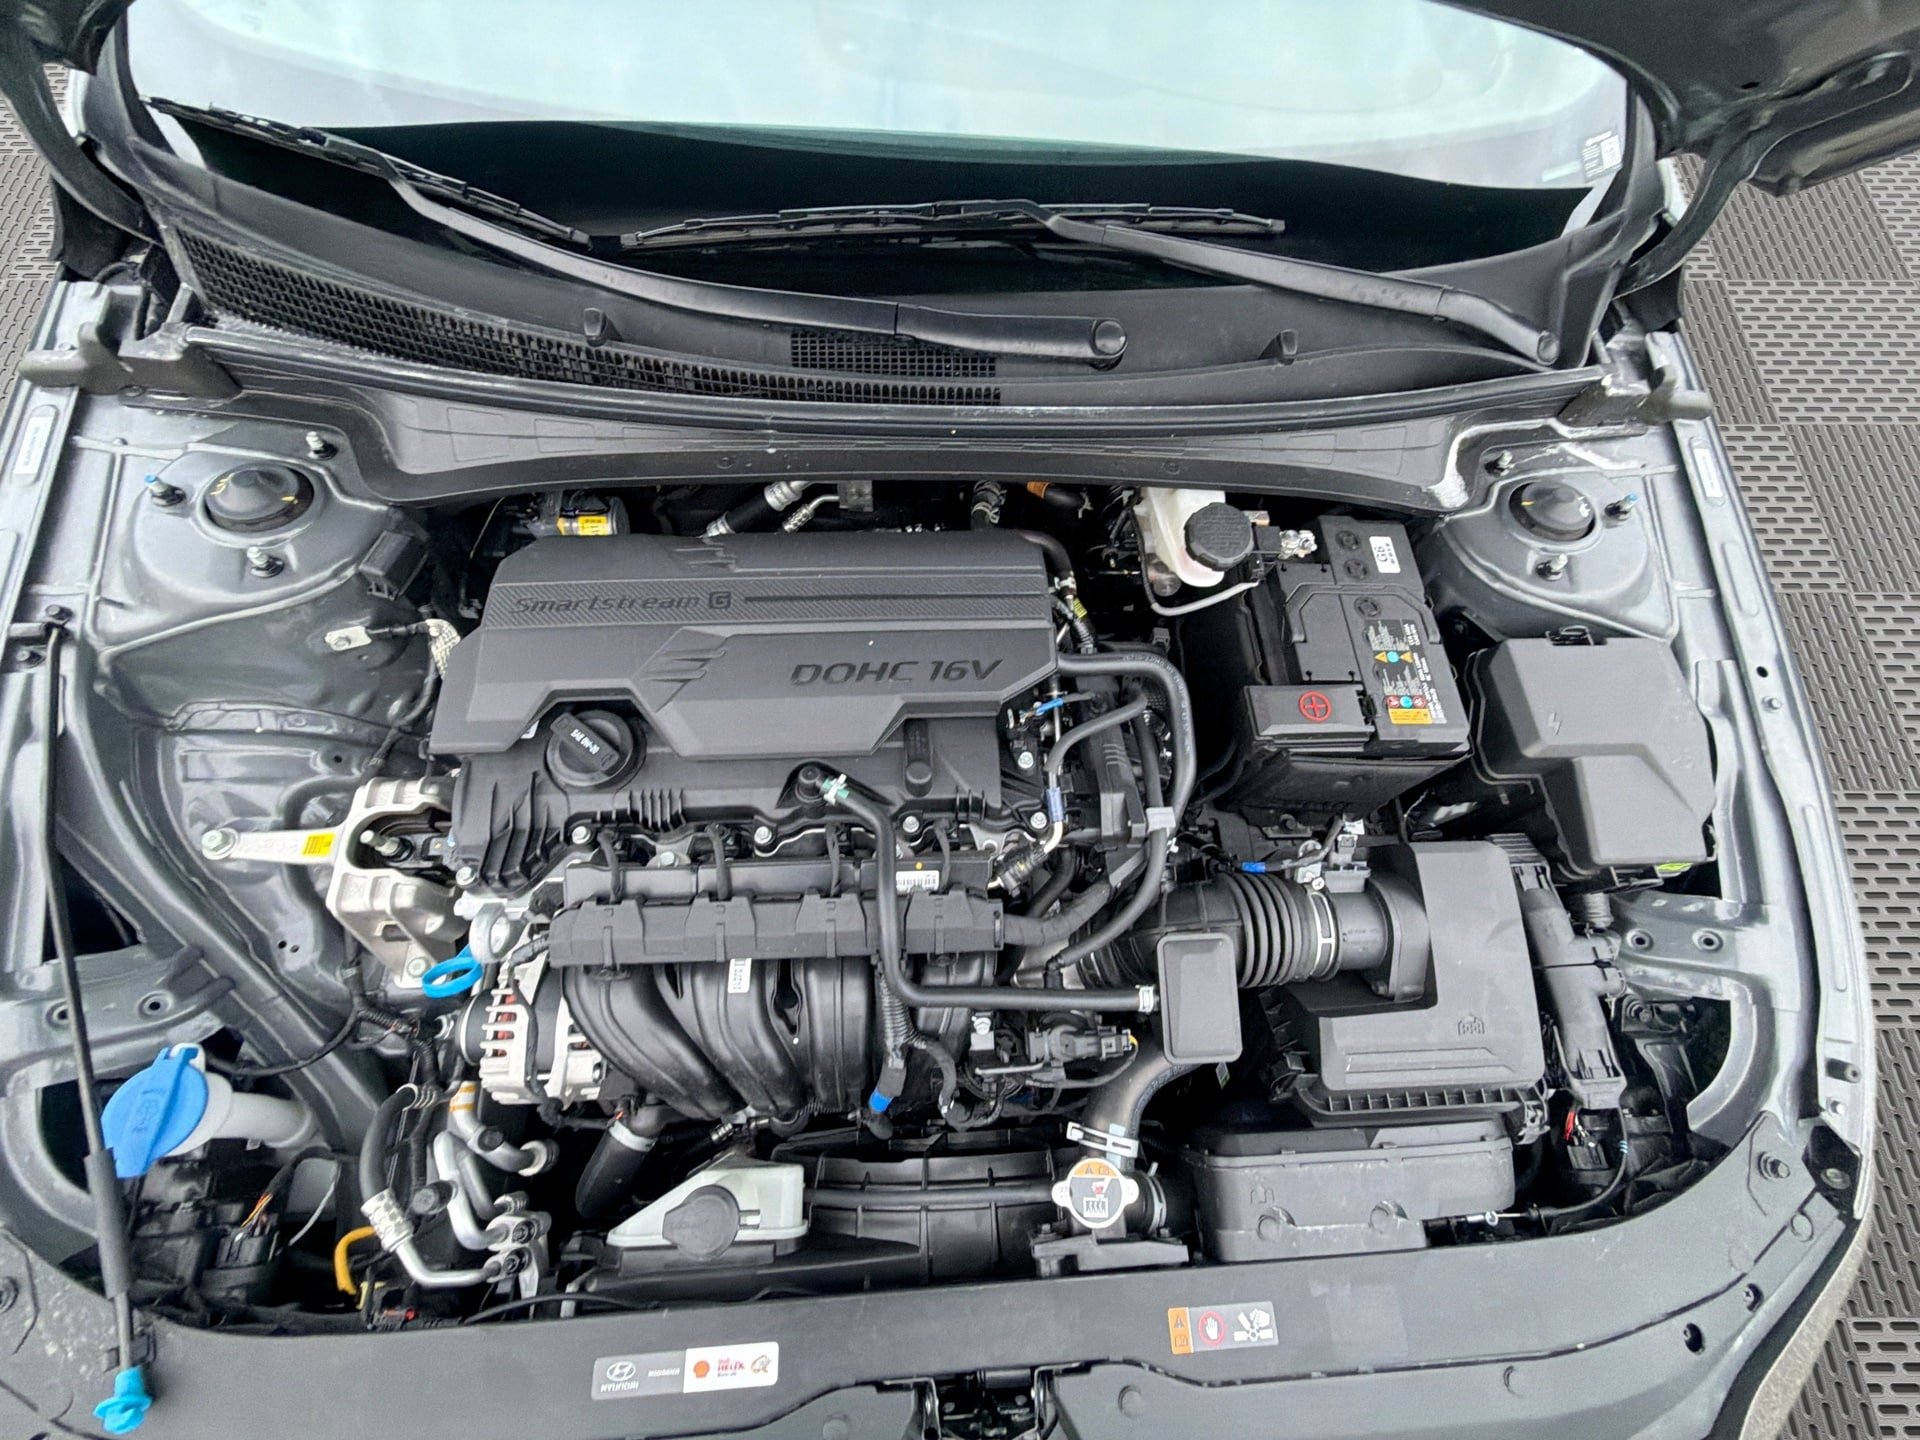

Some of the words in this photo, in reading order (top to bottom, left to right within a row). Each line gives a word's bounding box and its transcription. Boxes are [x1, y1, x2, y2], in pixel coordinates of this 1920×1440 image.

[511, 595, 700, 613] Smartstream
[791, 661, 919, 686] DOHC
[929, 658, 1004, 682] 16V
[570, 728, 585, 742] SAE
[600, 1381, 639, 1393] HYUNDAI
